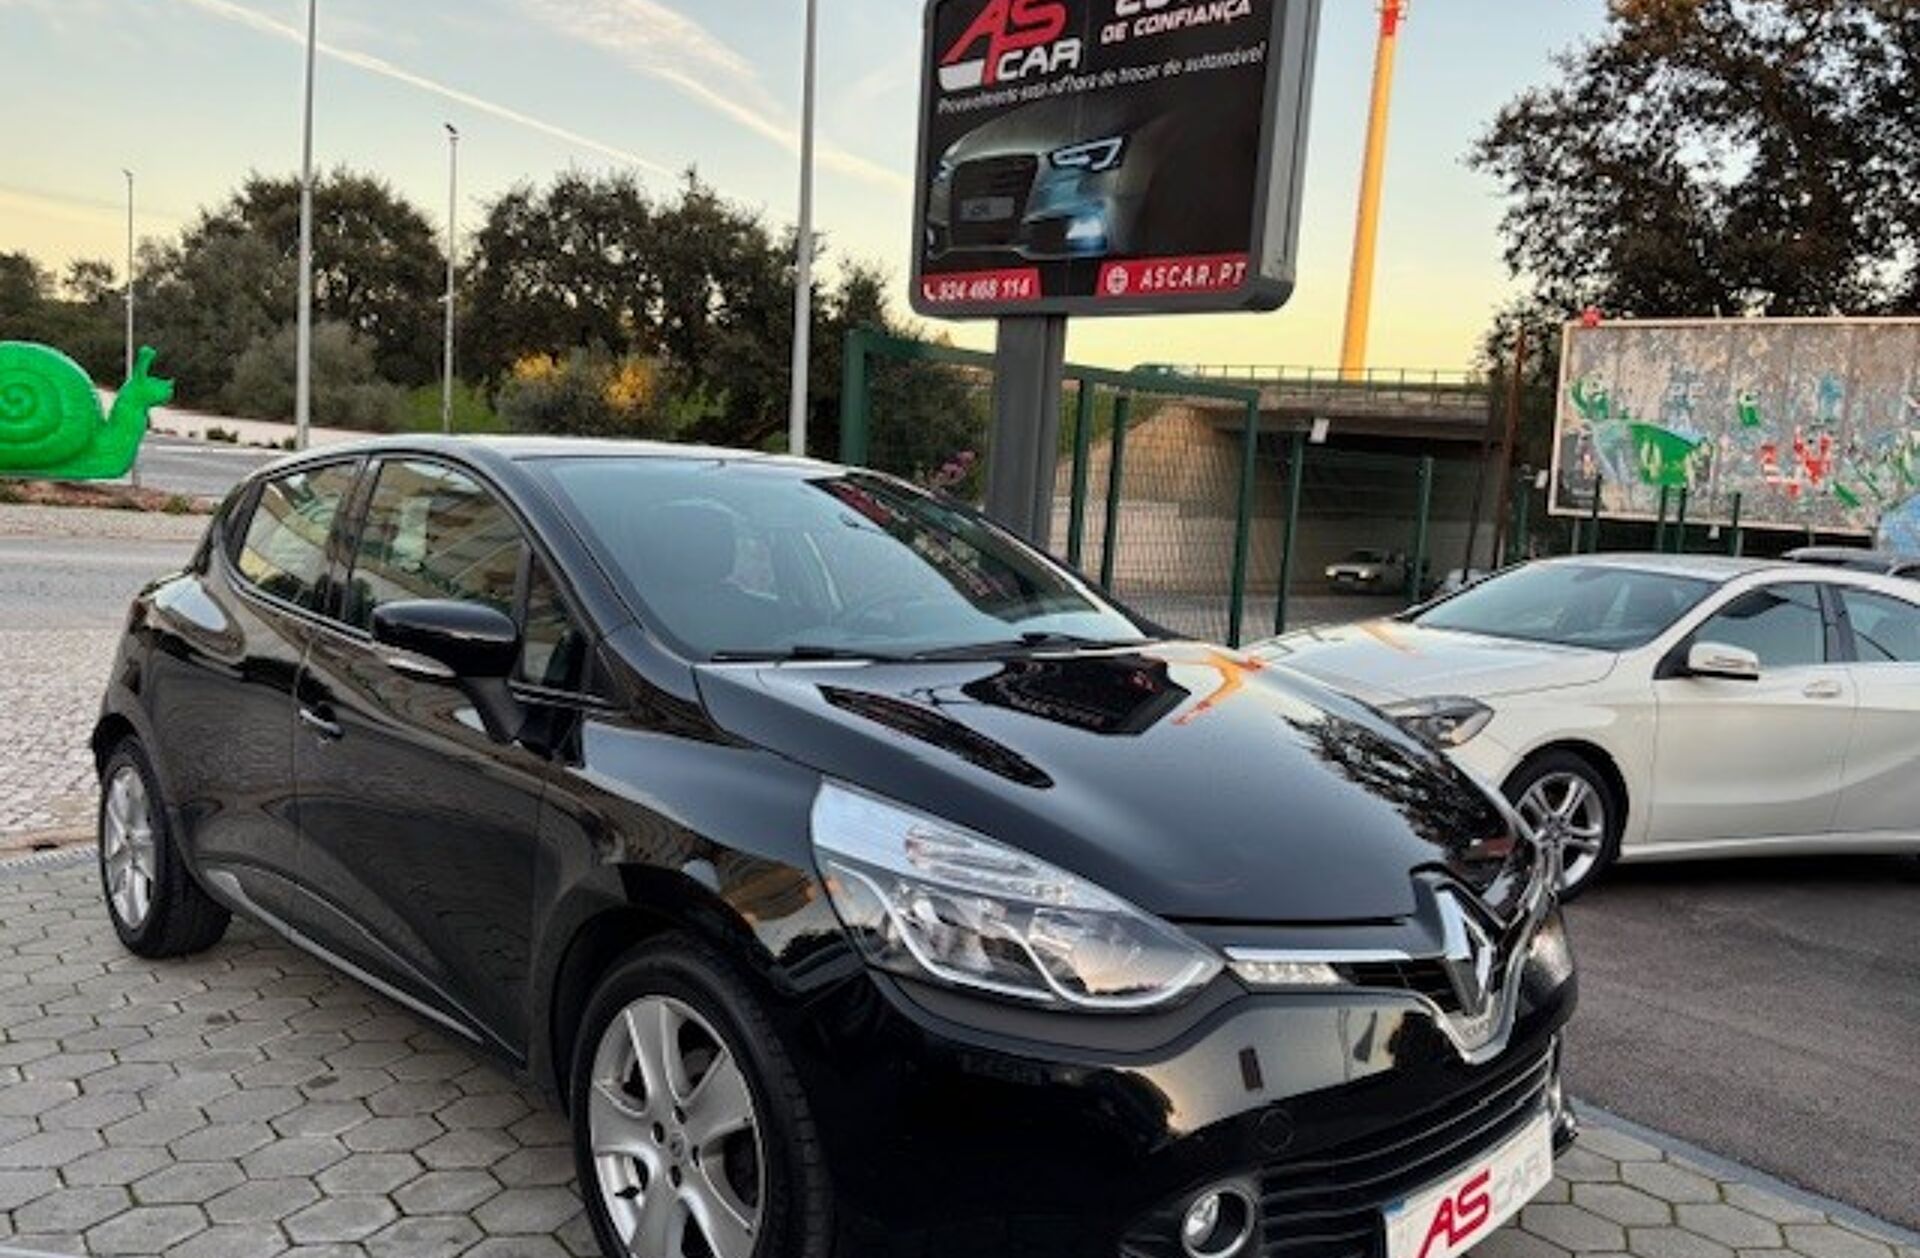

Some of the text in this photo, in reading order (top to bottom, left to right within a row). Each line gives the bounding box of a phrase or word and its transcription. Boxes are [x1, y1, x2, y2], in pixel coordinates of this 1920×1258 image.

[940, 0, 1067, 87] AS
[1100, 22, 1128, 45] DE
[1133, 0, 1251, 37] CONFIANÇA
[996, 37, 1081, 80] CAR
[1139, 261, 1247, 290] ASCAR.PT
[1417, 1167, 1490, 1258] AS
